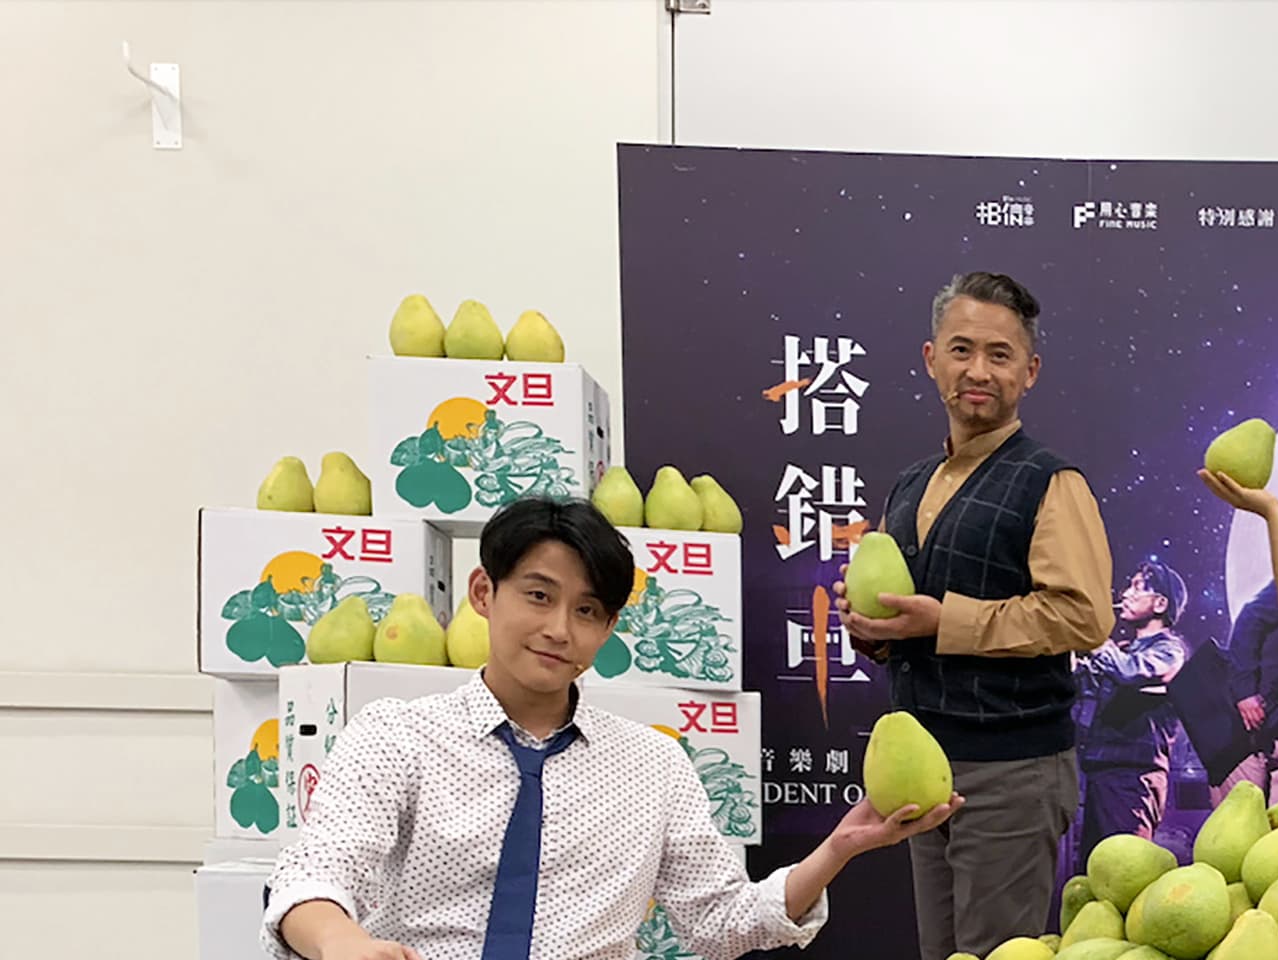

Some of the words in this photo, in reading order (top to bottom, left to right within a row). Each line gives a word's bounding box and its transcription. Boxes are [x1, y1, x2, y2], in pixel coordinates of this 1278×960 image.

[1198, 207, 1275, 227] 特別感謝
[485, 372, 554, 407] 文旦
[322, 526, 393, 563] 文旦
[646, 540, 714, 576] 文旦
[678, 701, 739, 734] 文旦
[763, 782, 838, 805] DENT
